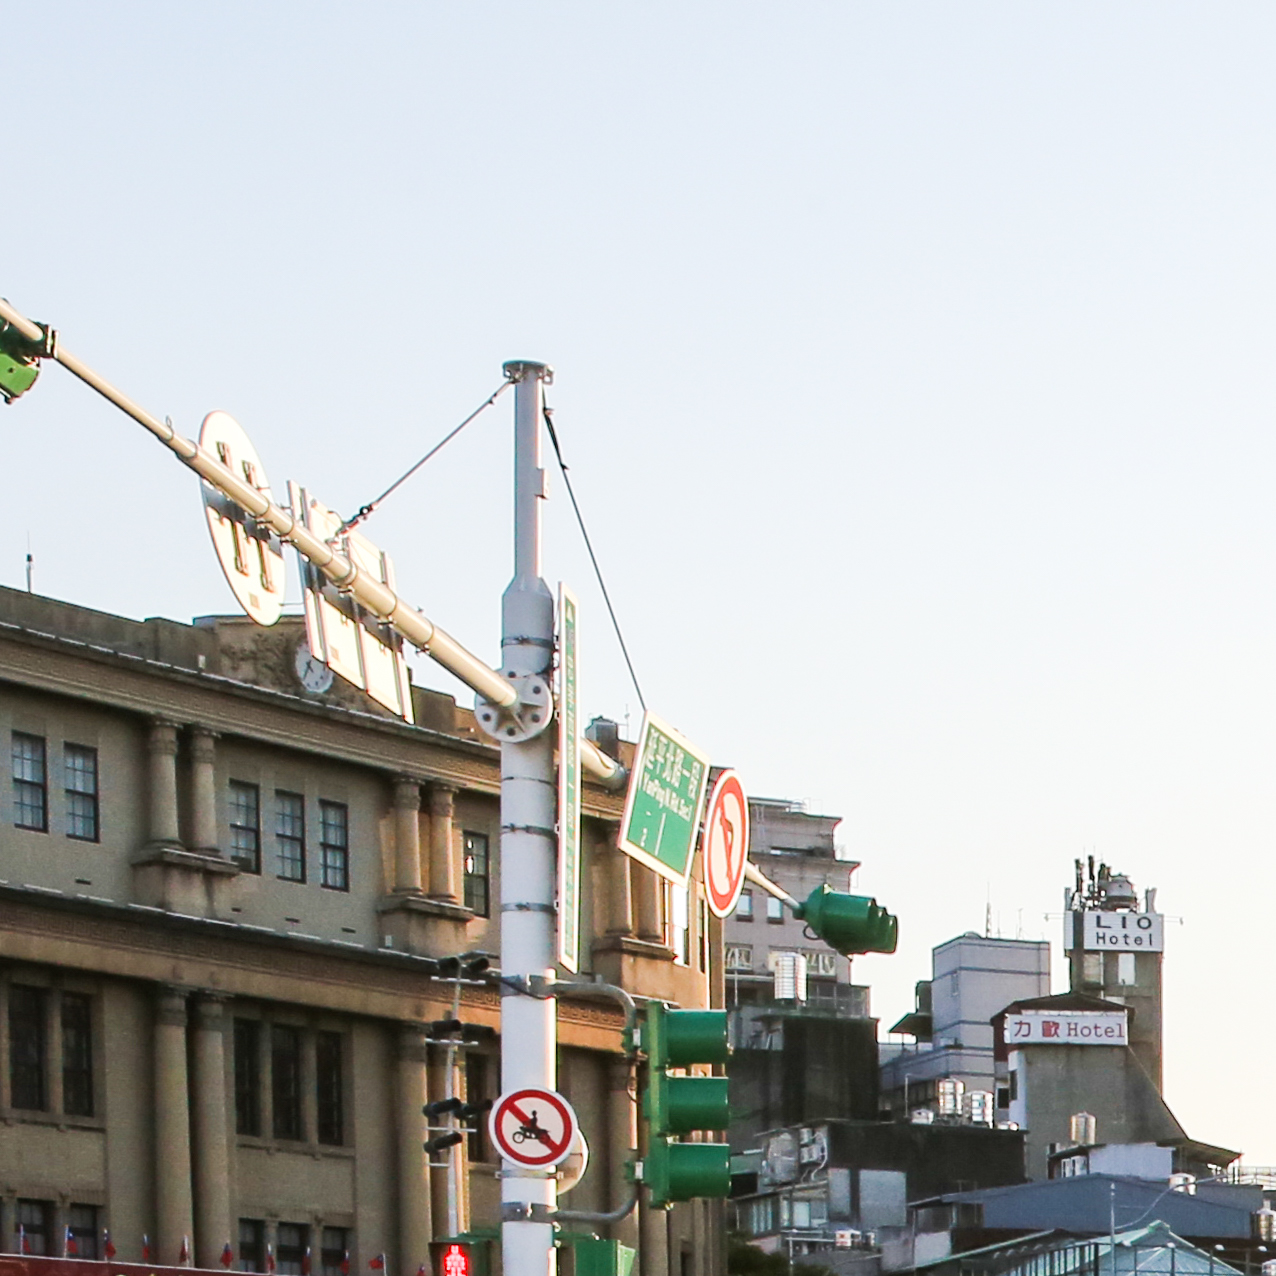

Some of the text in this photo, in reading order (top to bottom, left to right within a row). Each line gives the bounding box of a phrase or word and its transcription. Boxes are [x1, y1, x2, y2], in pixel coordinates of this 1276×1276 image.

[1096, 915, 1153, 930] LIO
[1096, 931, 1153, 946] Hotel
[1067, 1022, 1125, 1038] Hotel
